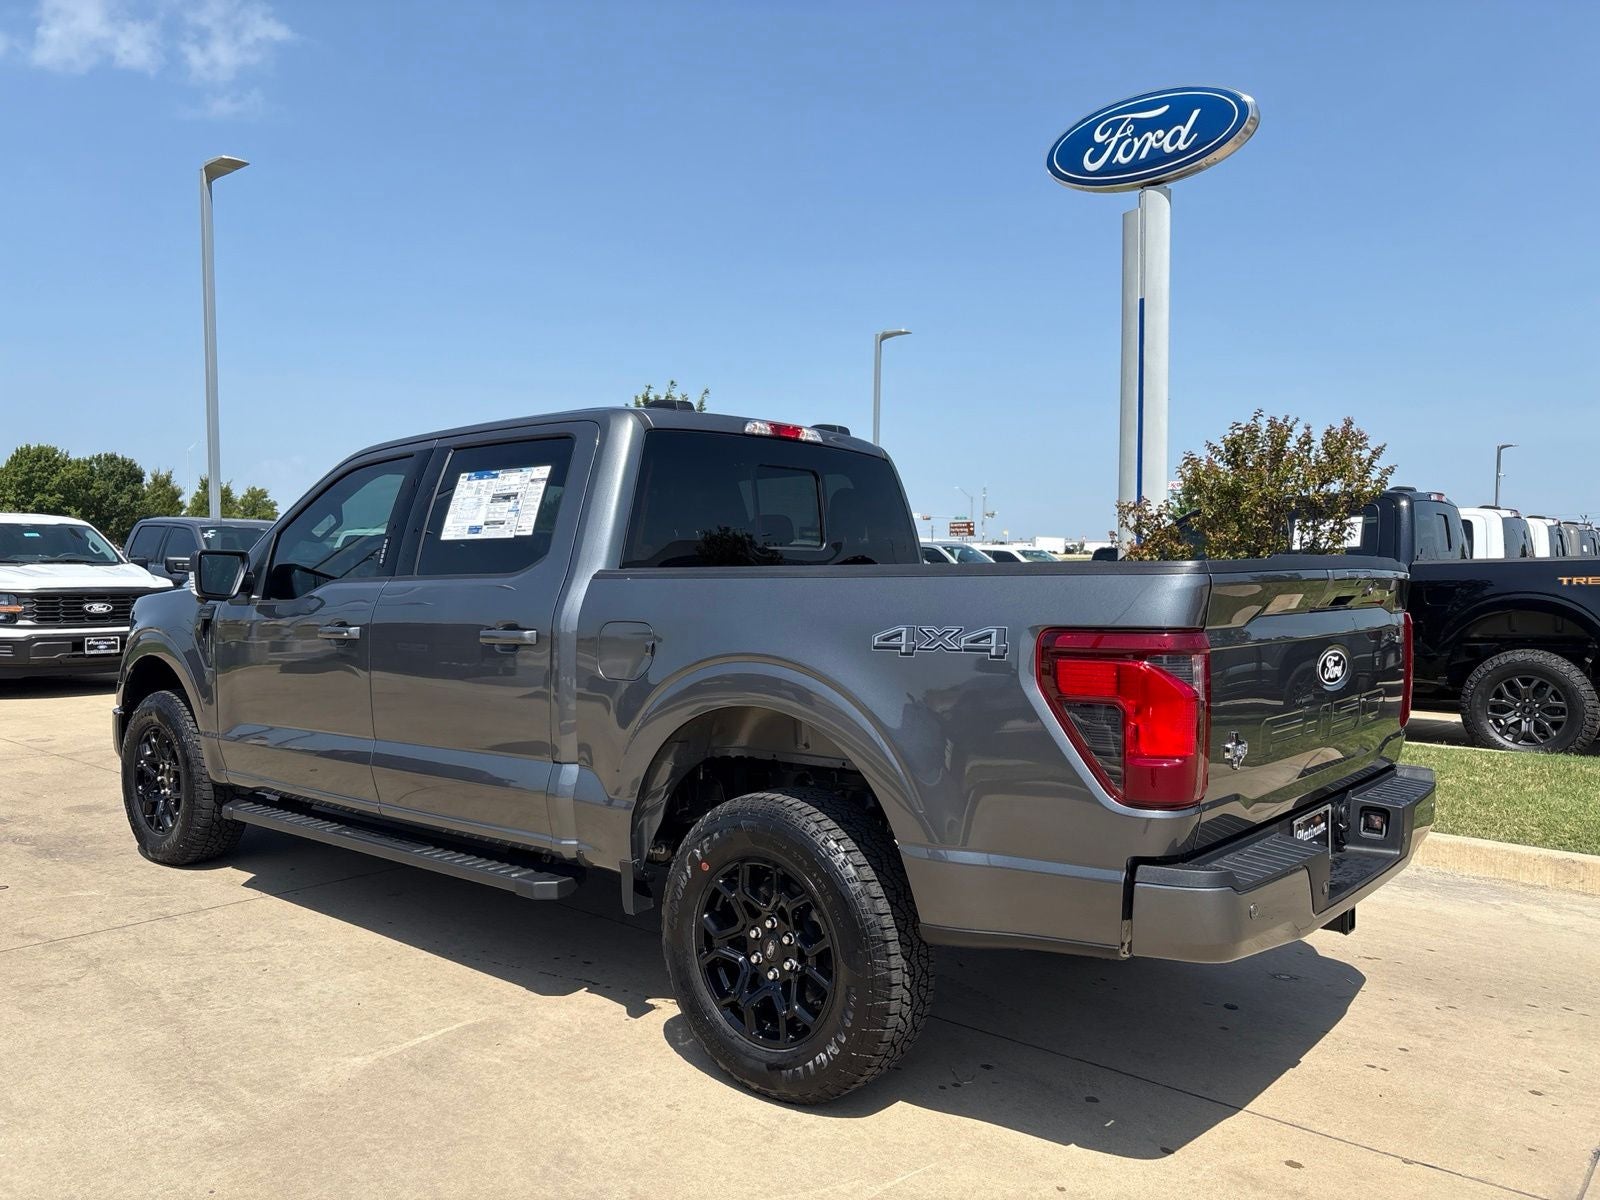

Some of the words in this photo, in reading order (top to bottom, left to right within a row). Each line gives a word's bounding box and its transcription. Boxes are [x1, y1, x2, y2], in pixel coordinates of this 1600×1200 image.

[1082, 104, 1201, 172] Ford
[1557, 576, 1600, 585] TRE
[1324, 655, 1344, 680] Ford
